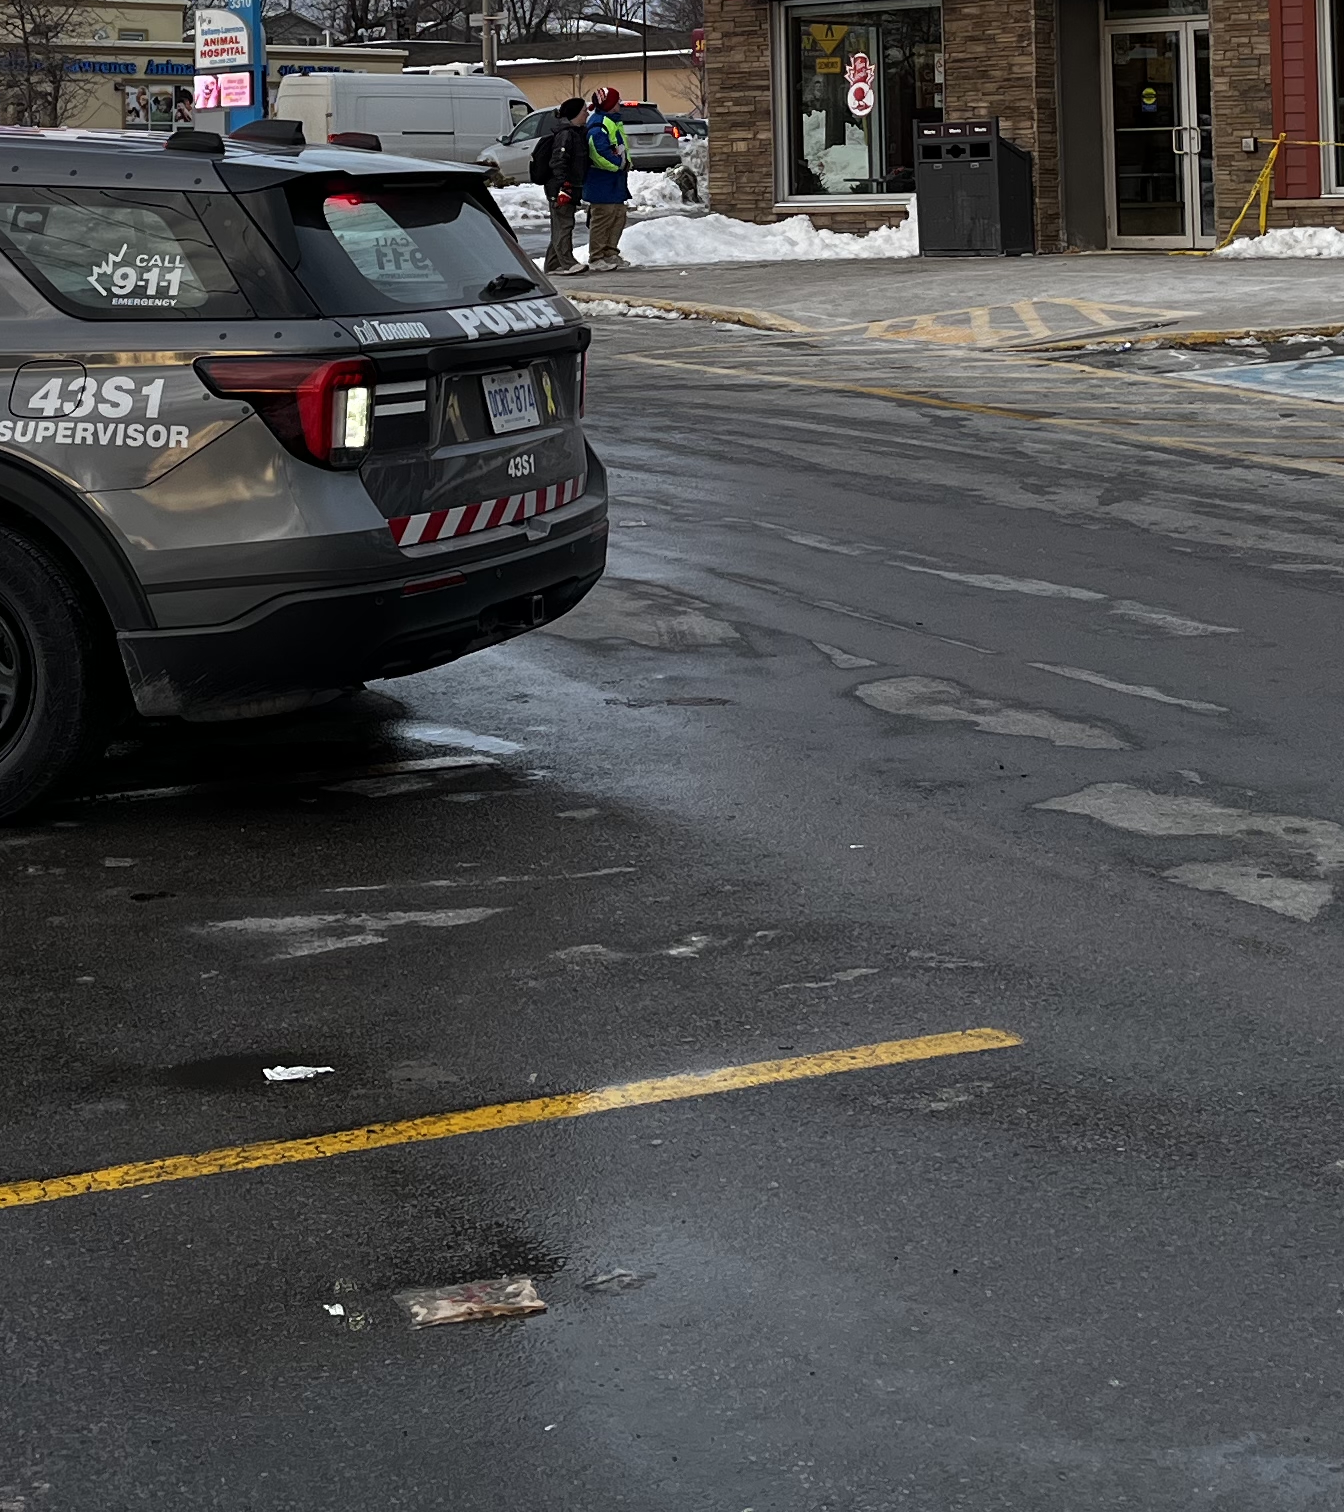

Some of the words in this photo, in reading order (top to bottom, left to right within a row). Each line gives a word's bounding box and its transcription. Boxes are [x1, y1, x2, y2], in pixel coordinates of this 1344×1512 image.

[203, 35, 240, 48] ANIMAL
[200, 46, 246, 59] HOSPITAL
[136, 254, 185, 267] CALL
[111, 267, 182, 296] 9-1-1
[112, 298, 177, 306] EMERGENCY
[447, 298, 565, 340] POLICE
[28, 376, 165, 419] 43S1
[508, 453, 535, 477] 43S1
